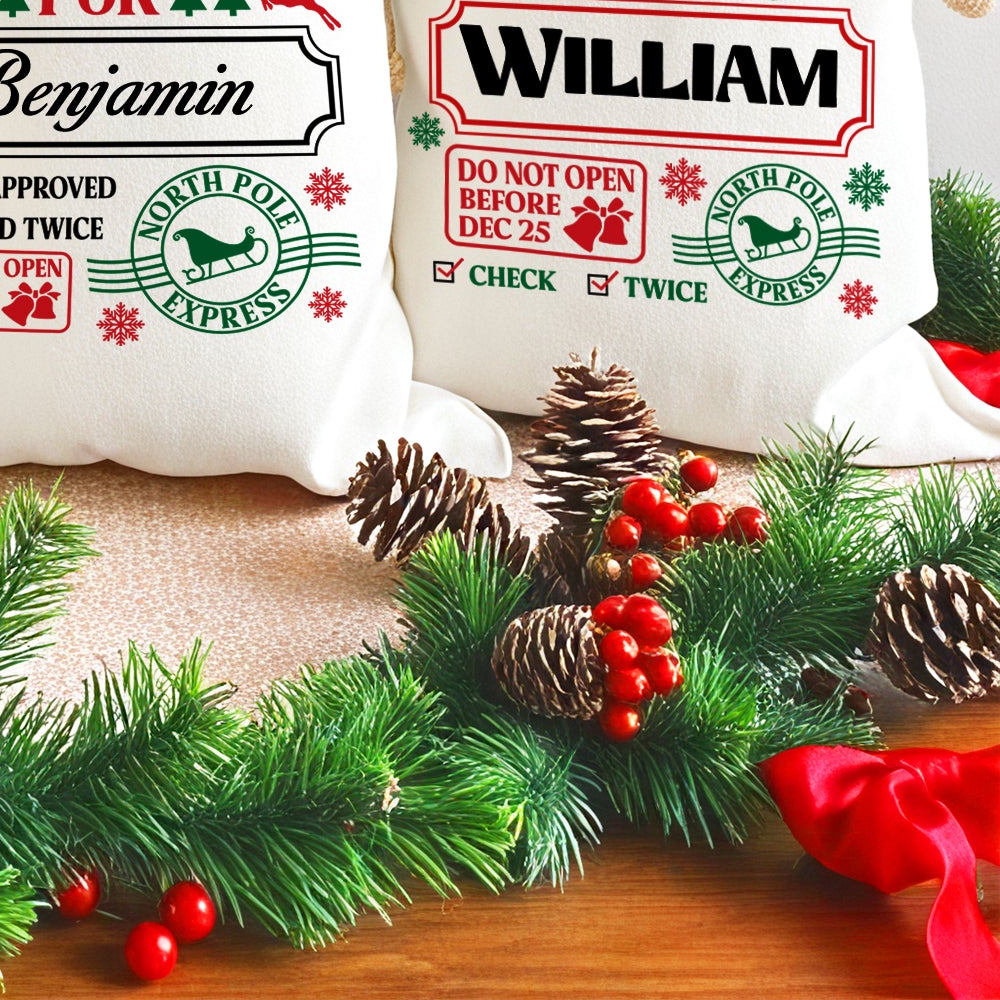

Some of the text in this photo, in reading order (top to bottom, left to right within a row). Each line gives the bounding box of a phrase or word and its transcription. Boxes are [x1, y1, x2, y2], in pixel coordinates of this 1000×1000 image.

[459, 24, 837, 108] WILLIAM
[458, 158, 634, 192] DO NOT OPEN
[138, 171, 300, 240] NORTH POLE
[460, 188, 560, 215] BEFORE
[711, 168, 836, 223] NORTH POLE
[23, 217, 103, 240] TWICE
[460, 216, 550, 243] DEC 25
[4, 258, 62, 278] OPEN
[470, 265, 707, 303] CHECK TWICE
[728, 266, 826, 301] EXPRESS
[162, 282, 290, 328] EXPRESS
